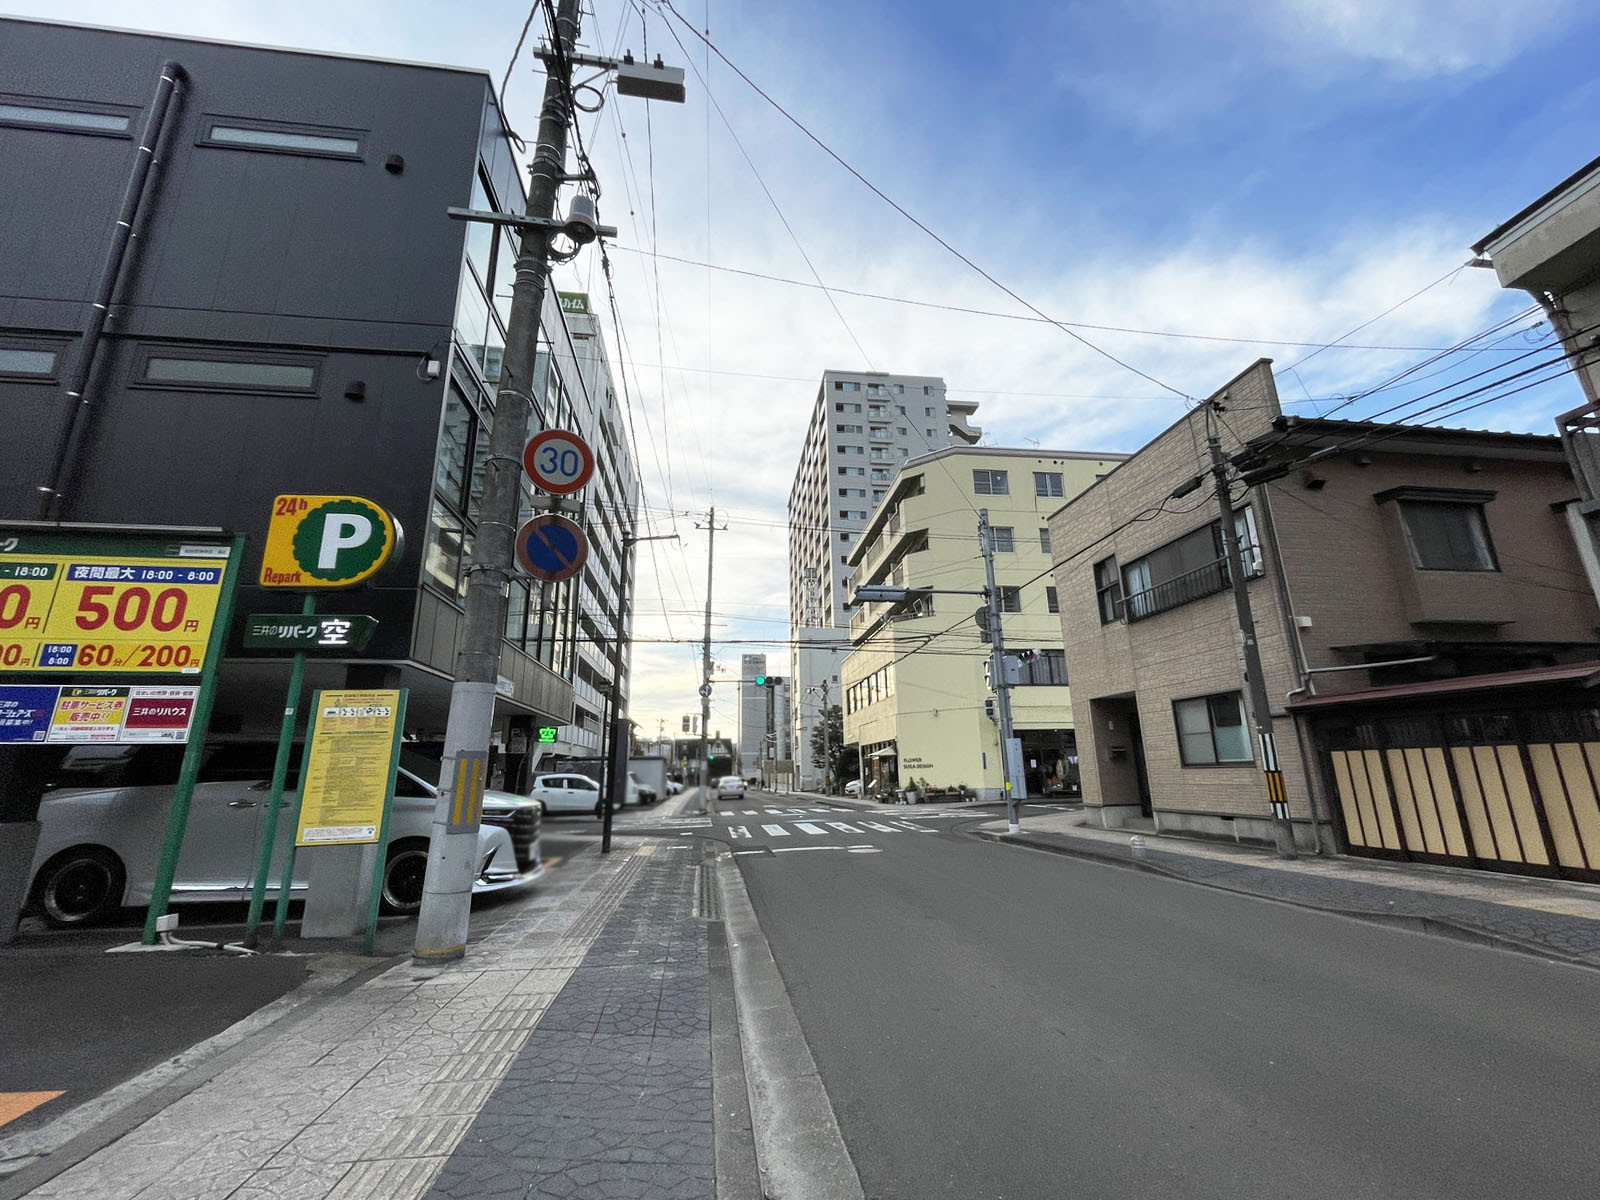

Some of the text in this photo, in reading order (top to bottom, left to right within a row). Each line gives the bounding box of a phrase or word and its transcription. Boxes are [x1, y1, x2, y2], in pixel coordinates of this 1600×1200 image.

[540, 447, 579, 477] 30
[275, 498, 308, 516] 24h
[317, 513, 373, 570] P
[15, 566, 49, 577] 18:00
[74, 566, 136, 580] 夜間最大
[141, 569, 174, 580] 18:00
[187, 571, 215, 581] 8:00
[263, 567, 302, 584] Repark
[252, 618, 352, 645] 三井のリパーク 空
[61, 700, 124, 710] 駐車サービス券
[132, 707, 187, 716] 三井のリハウス
[539, 727, 557, 743] 空
